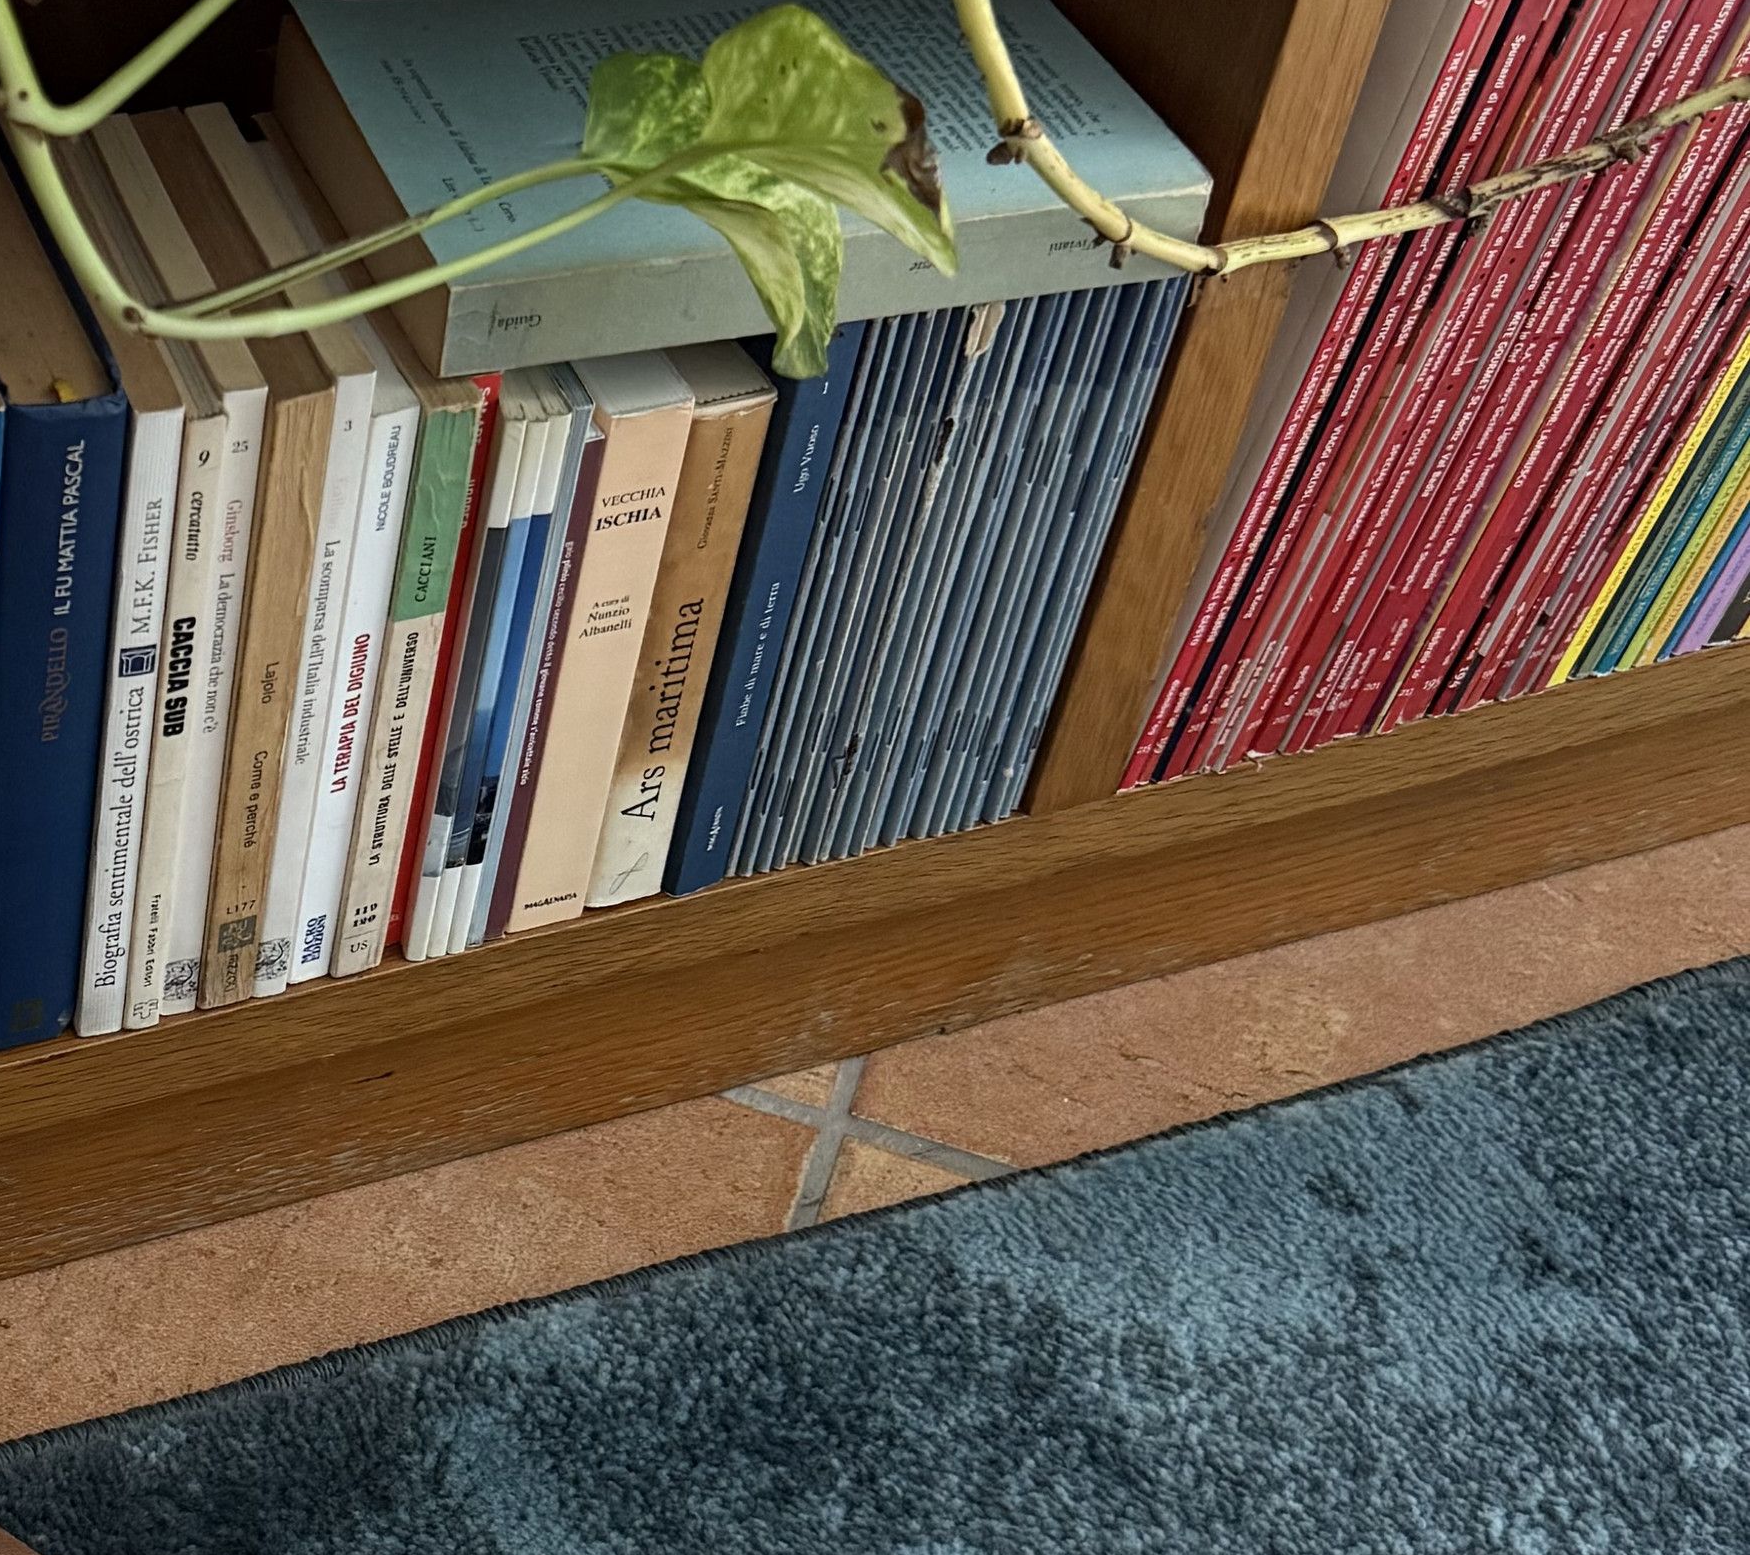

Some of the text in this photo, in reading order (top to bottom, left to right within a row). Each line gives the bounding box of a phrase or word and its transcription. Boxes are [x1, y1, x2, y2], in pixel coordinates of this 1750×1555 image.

[1430, 228, 1458, 271] NATALE
[1411, 280, 1434, 312] CASA
[1393, 311, 1419, 351] TASSA
[1511, 425, 1550, 491] LAMBRUSCO
[594, 507, 662, 531] ISCHIA
[602, 487, 665, 507] VECCHIA
[54, 438, 85, 615] IL FU MATTIA PASCAL
[413, 535, 436, 603] CACCIANI
[130, 569, 156, 634] M.F.K.
[579, 619, 632, 639] Albanelli
[587, 606, 630, 623] Nunzio
[161, 614, 197, 739] CACCIA SUB
[394, 631, 419, 709] DELL'UNIVERSO
[330, 632, 371, 794] LA TERAPIA DEL DIGIUNO
[620, 591, 708, 821] Ars maritima
[386, 725, 403, 758] STELLE
[380, 761, 397, 791] DELLE
[101, 792, 134, 905] sentimentale
[371, 794, 392, 850] STRUTTURA
[368, 852, 381, 867] LA
[93, 909, 128, 989] Biografia
